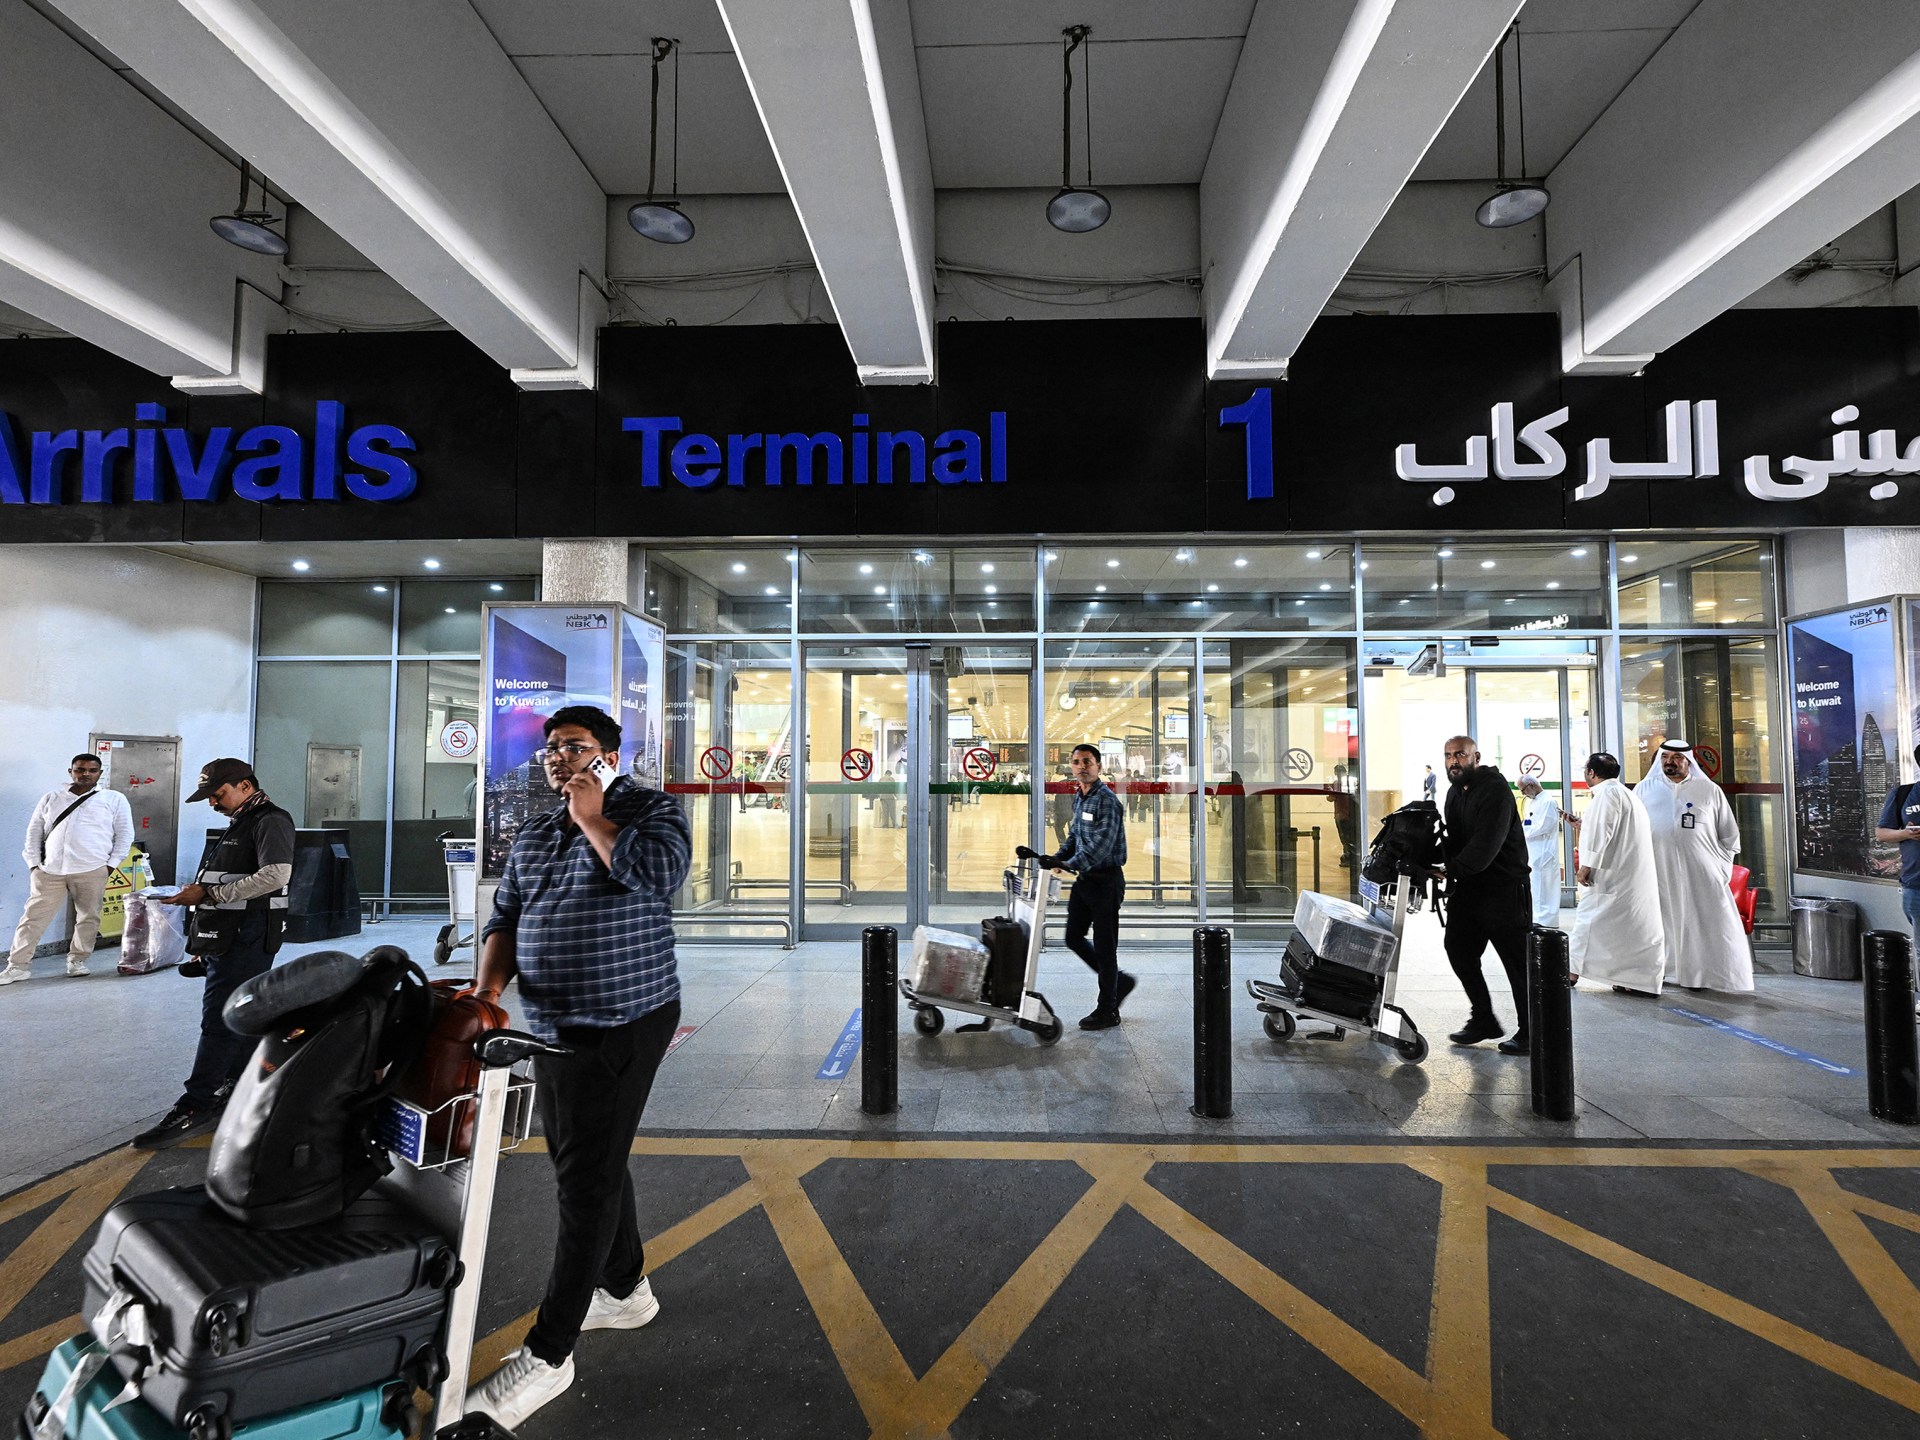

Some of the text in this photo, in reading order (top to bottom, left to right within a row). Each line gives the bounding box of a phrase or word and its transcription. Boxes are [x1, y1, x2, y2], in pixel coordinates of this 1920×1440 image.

[621, 387, 1273, 500] Terminal 1
[1395, 400, 1720, 506] الركاب
[565, 613, 592, 623] الوطني
[1849, 609, 1874, 619] الوطني
[1849, 616, 1873, 627] NBK
[494, 678, 549, 690] Welcome
[1796, 681, 1840, 693] Welcome
[494, 695, 550, 706] to Kuwait
[1797, 699, 1807, 709] to
[1808, 695, 1842, 708] Kuwait
